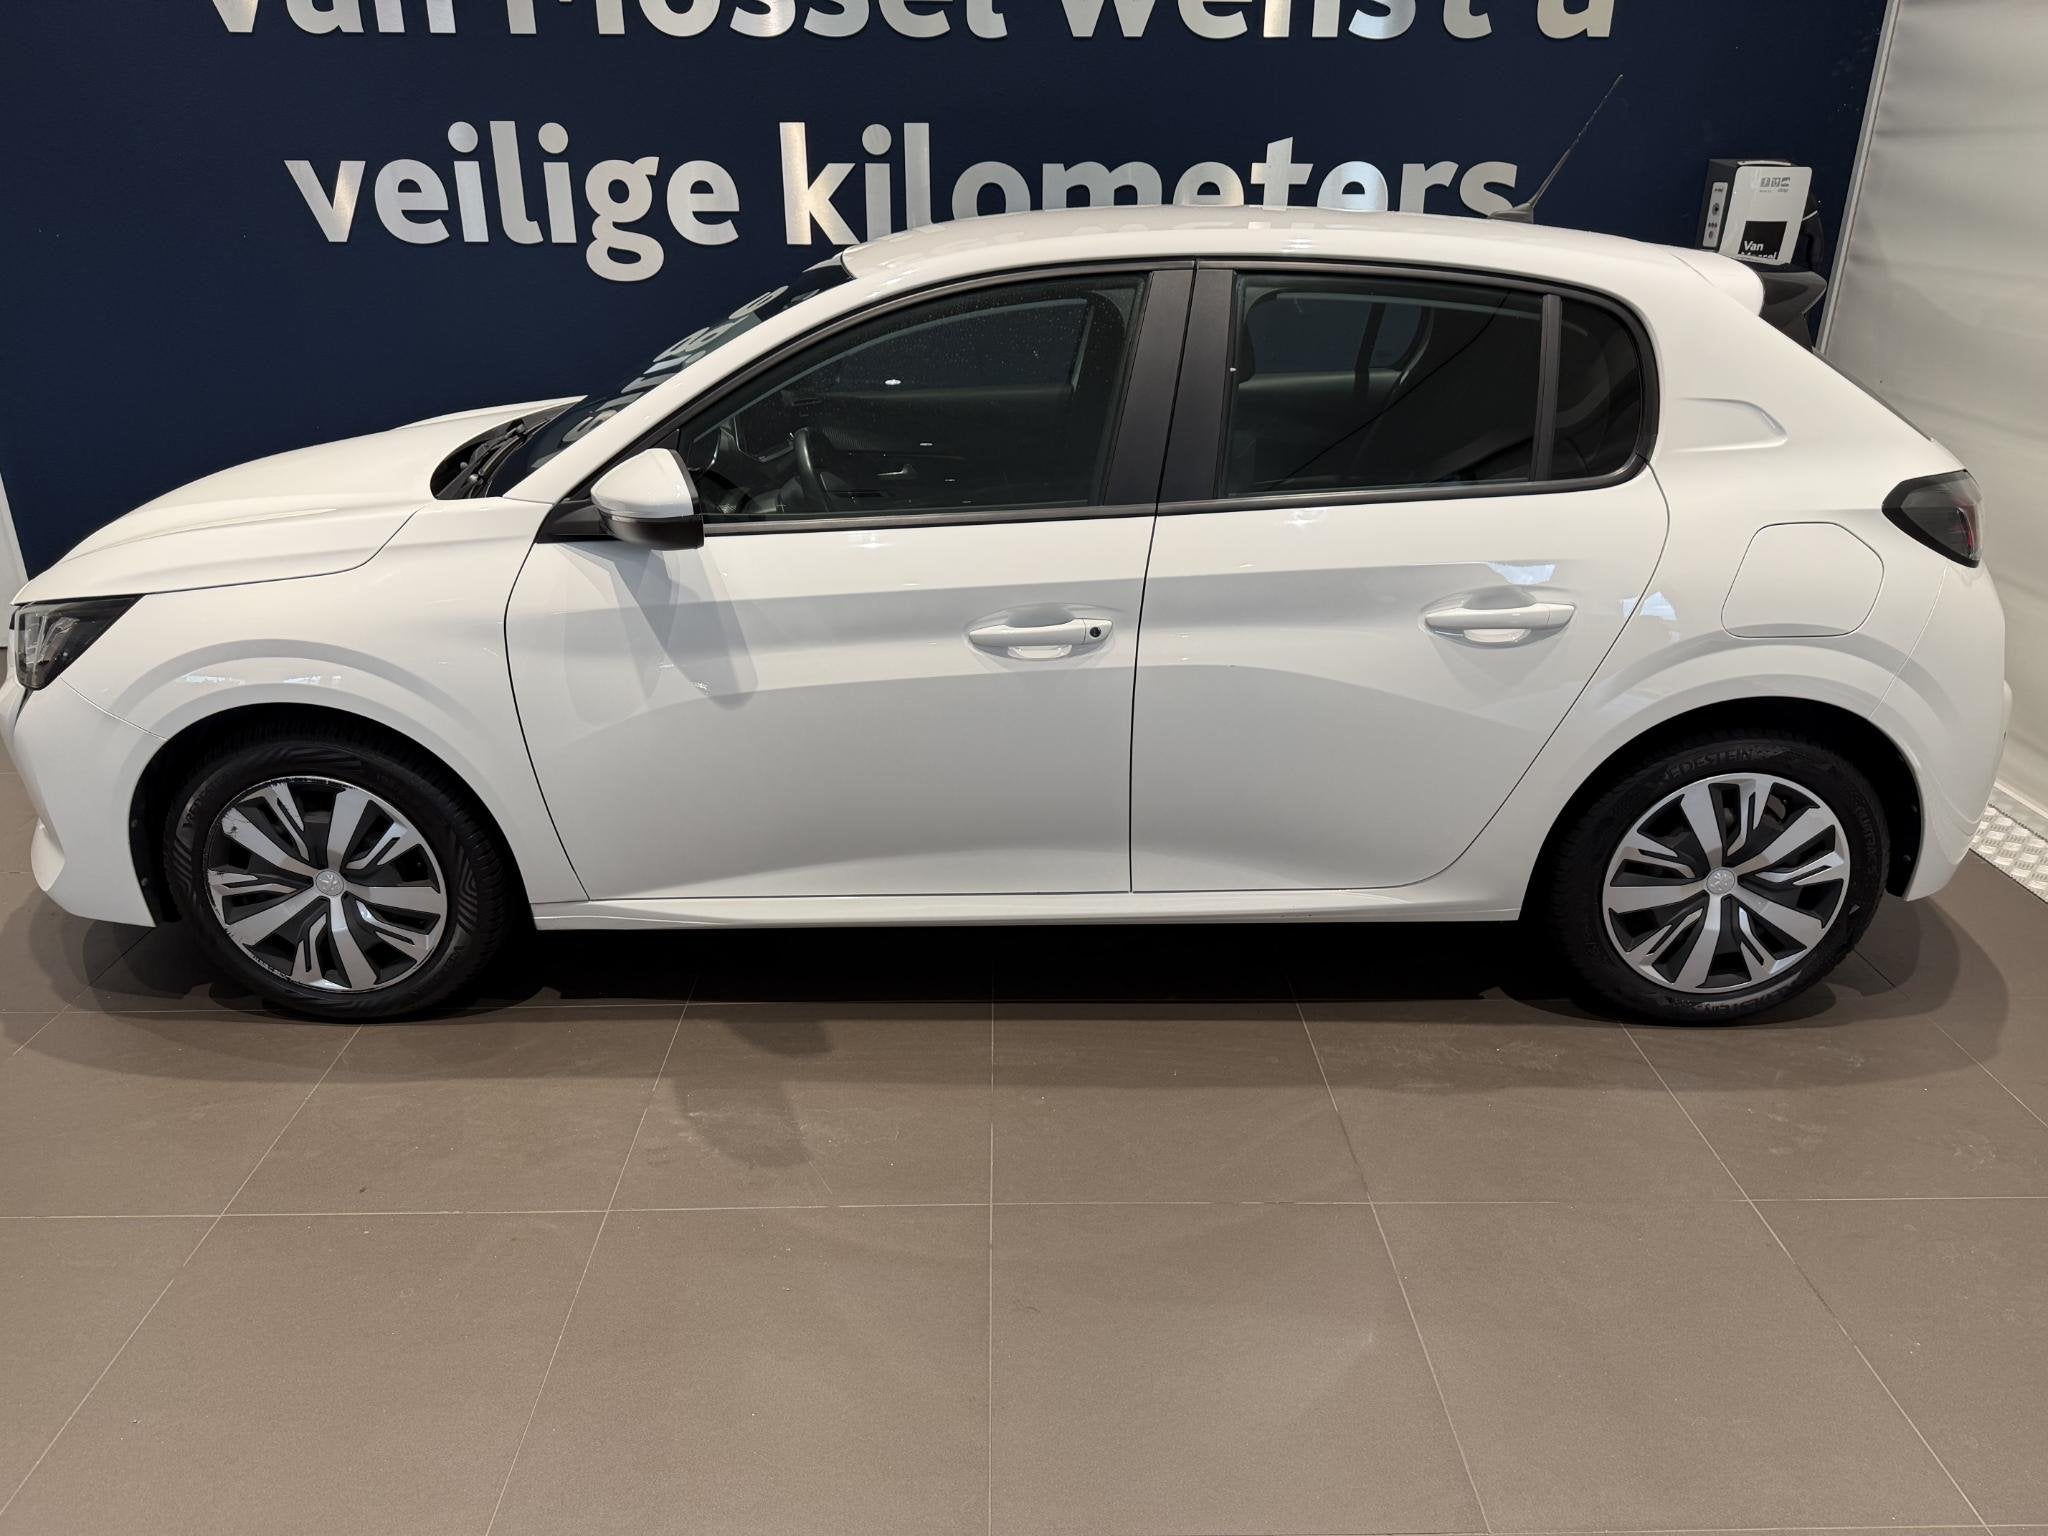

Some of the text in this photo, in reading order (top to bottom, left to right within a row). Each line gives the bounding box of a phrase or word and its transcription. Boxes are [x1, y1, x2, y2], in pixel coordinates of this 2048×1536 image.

[284, 120, 1519, 282] veilige kilometers
[1743, 240, 1765, 251] Van
